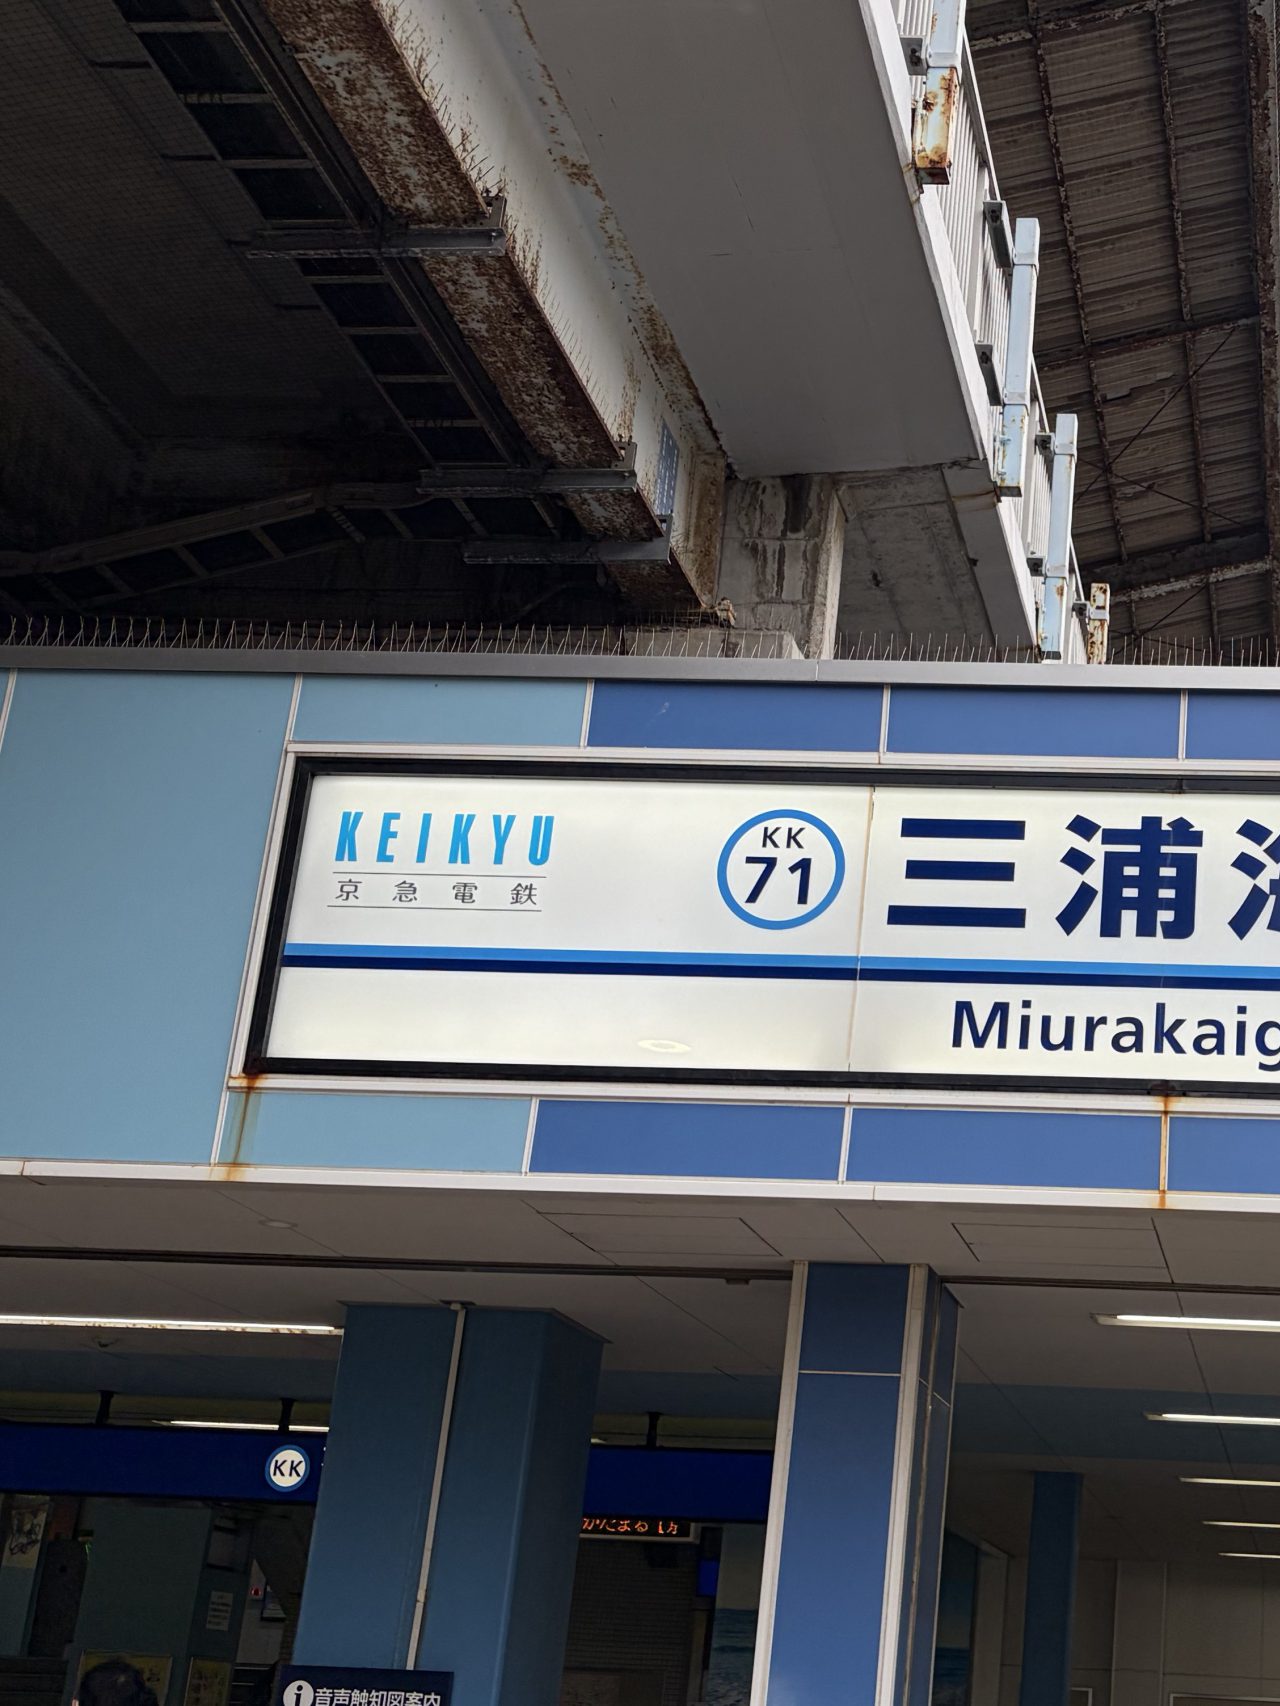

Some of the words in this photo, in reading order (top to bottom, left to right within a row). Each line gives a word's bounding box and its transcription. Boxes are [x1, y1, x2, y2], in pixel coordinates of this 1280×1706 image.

[334, 811, 554, 866] KEIKYU
[761, 826, 805, 849] KK
[335, 878, 538, 906] 京急電鉄
[744, 856, 812, 905] 71
[272, 1459, 303, 1478] KK
